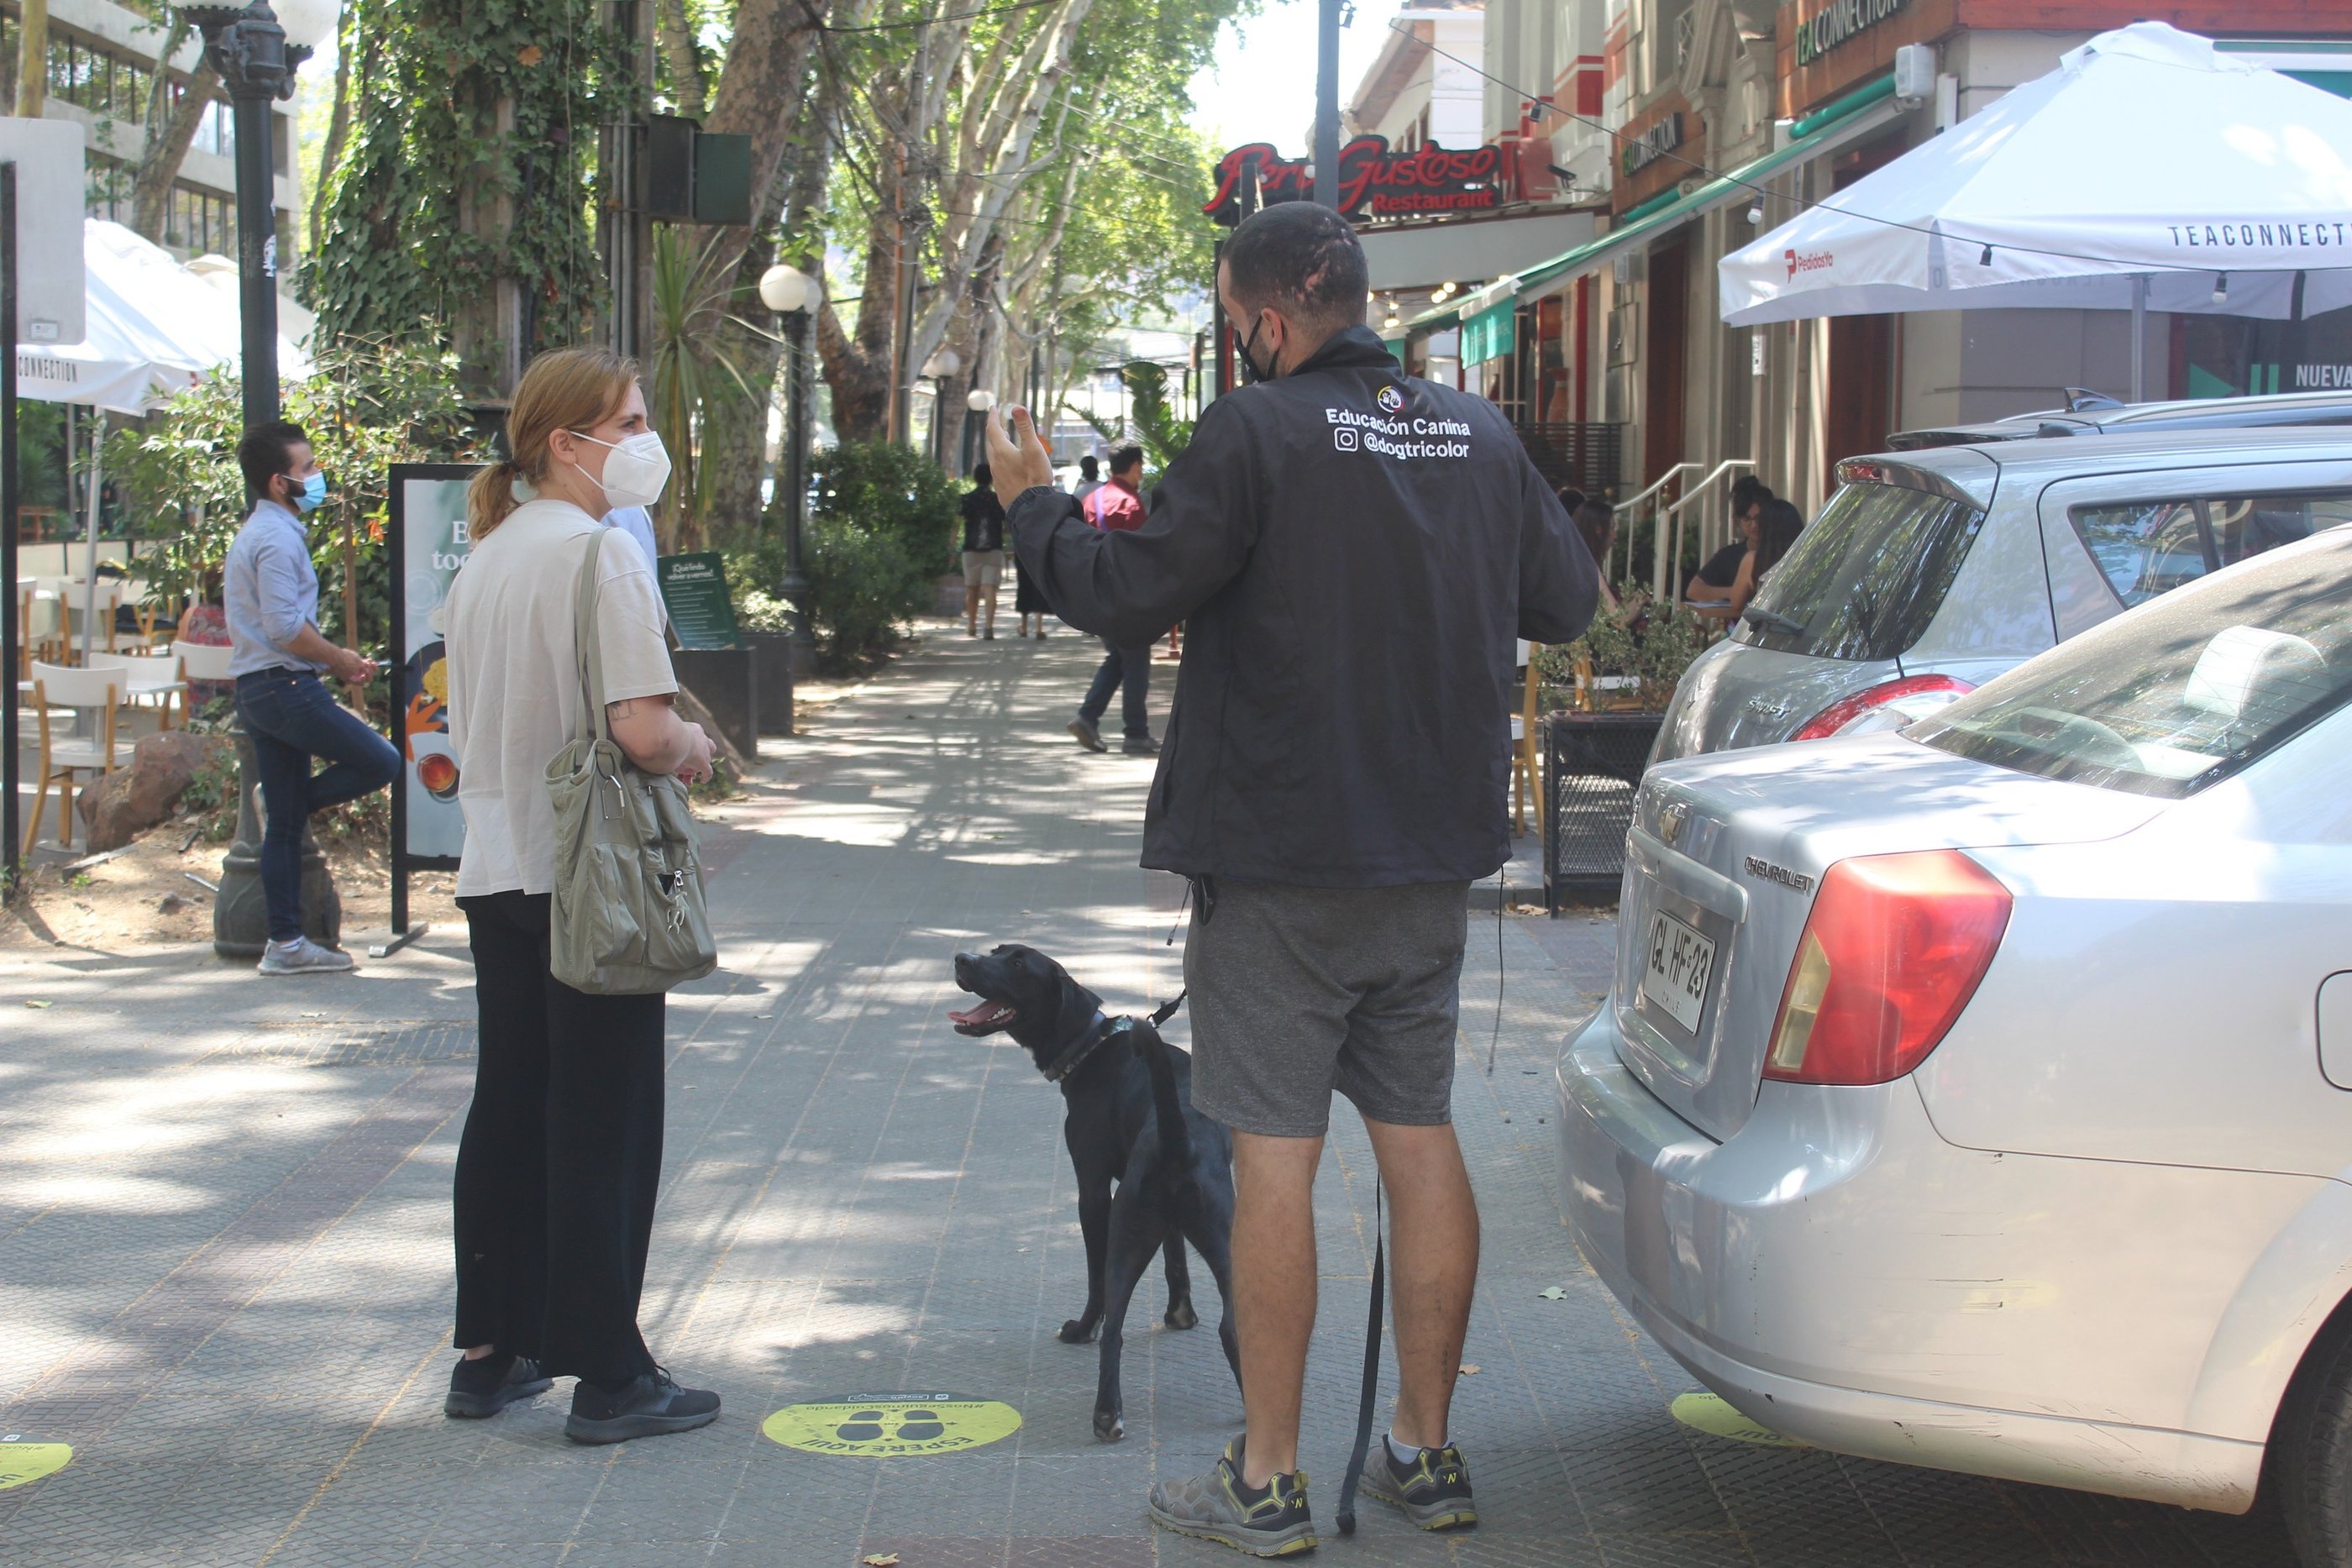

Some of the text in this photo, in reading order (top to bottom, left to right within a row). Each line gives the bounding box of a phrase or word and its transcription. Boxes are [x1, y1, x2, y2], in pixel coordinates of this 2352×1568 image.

[1336, 139, 1496, 213] Gustoso
[1372, 190, 1494, 210] Restaurant
[2167, 223, 2352, 246] TEACONNECT
[1326, 408, 1471, 436] Educación Canina
[1363, 432, 1469, 460] @dogtricolor
[1745, 857, 1814, 890] CHEVROLET
[794, 1436, 974, 1453] ESPERE AQUÍ
